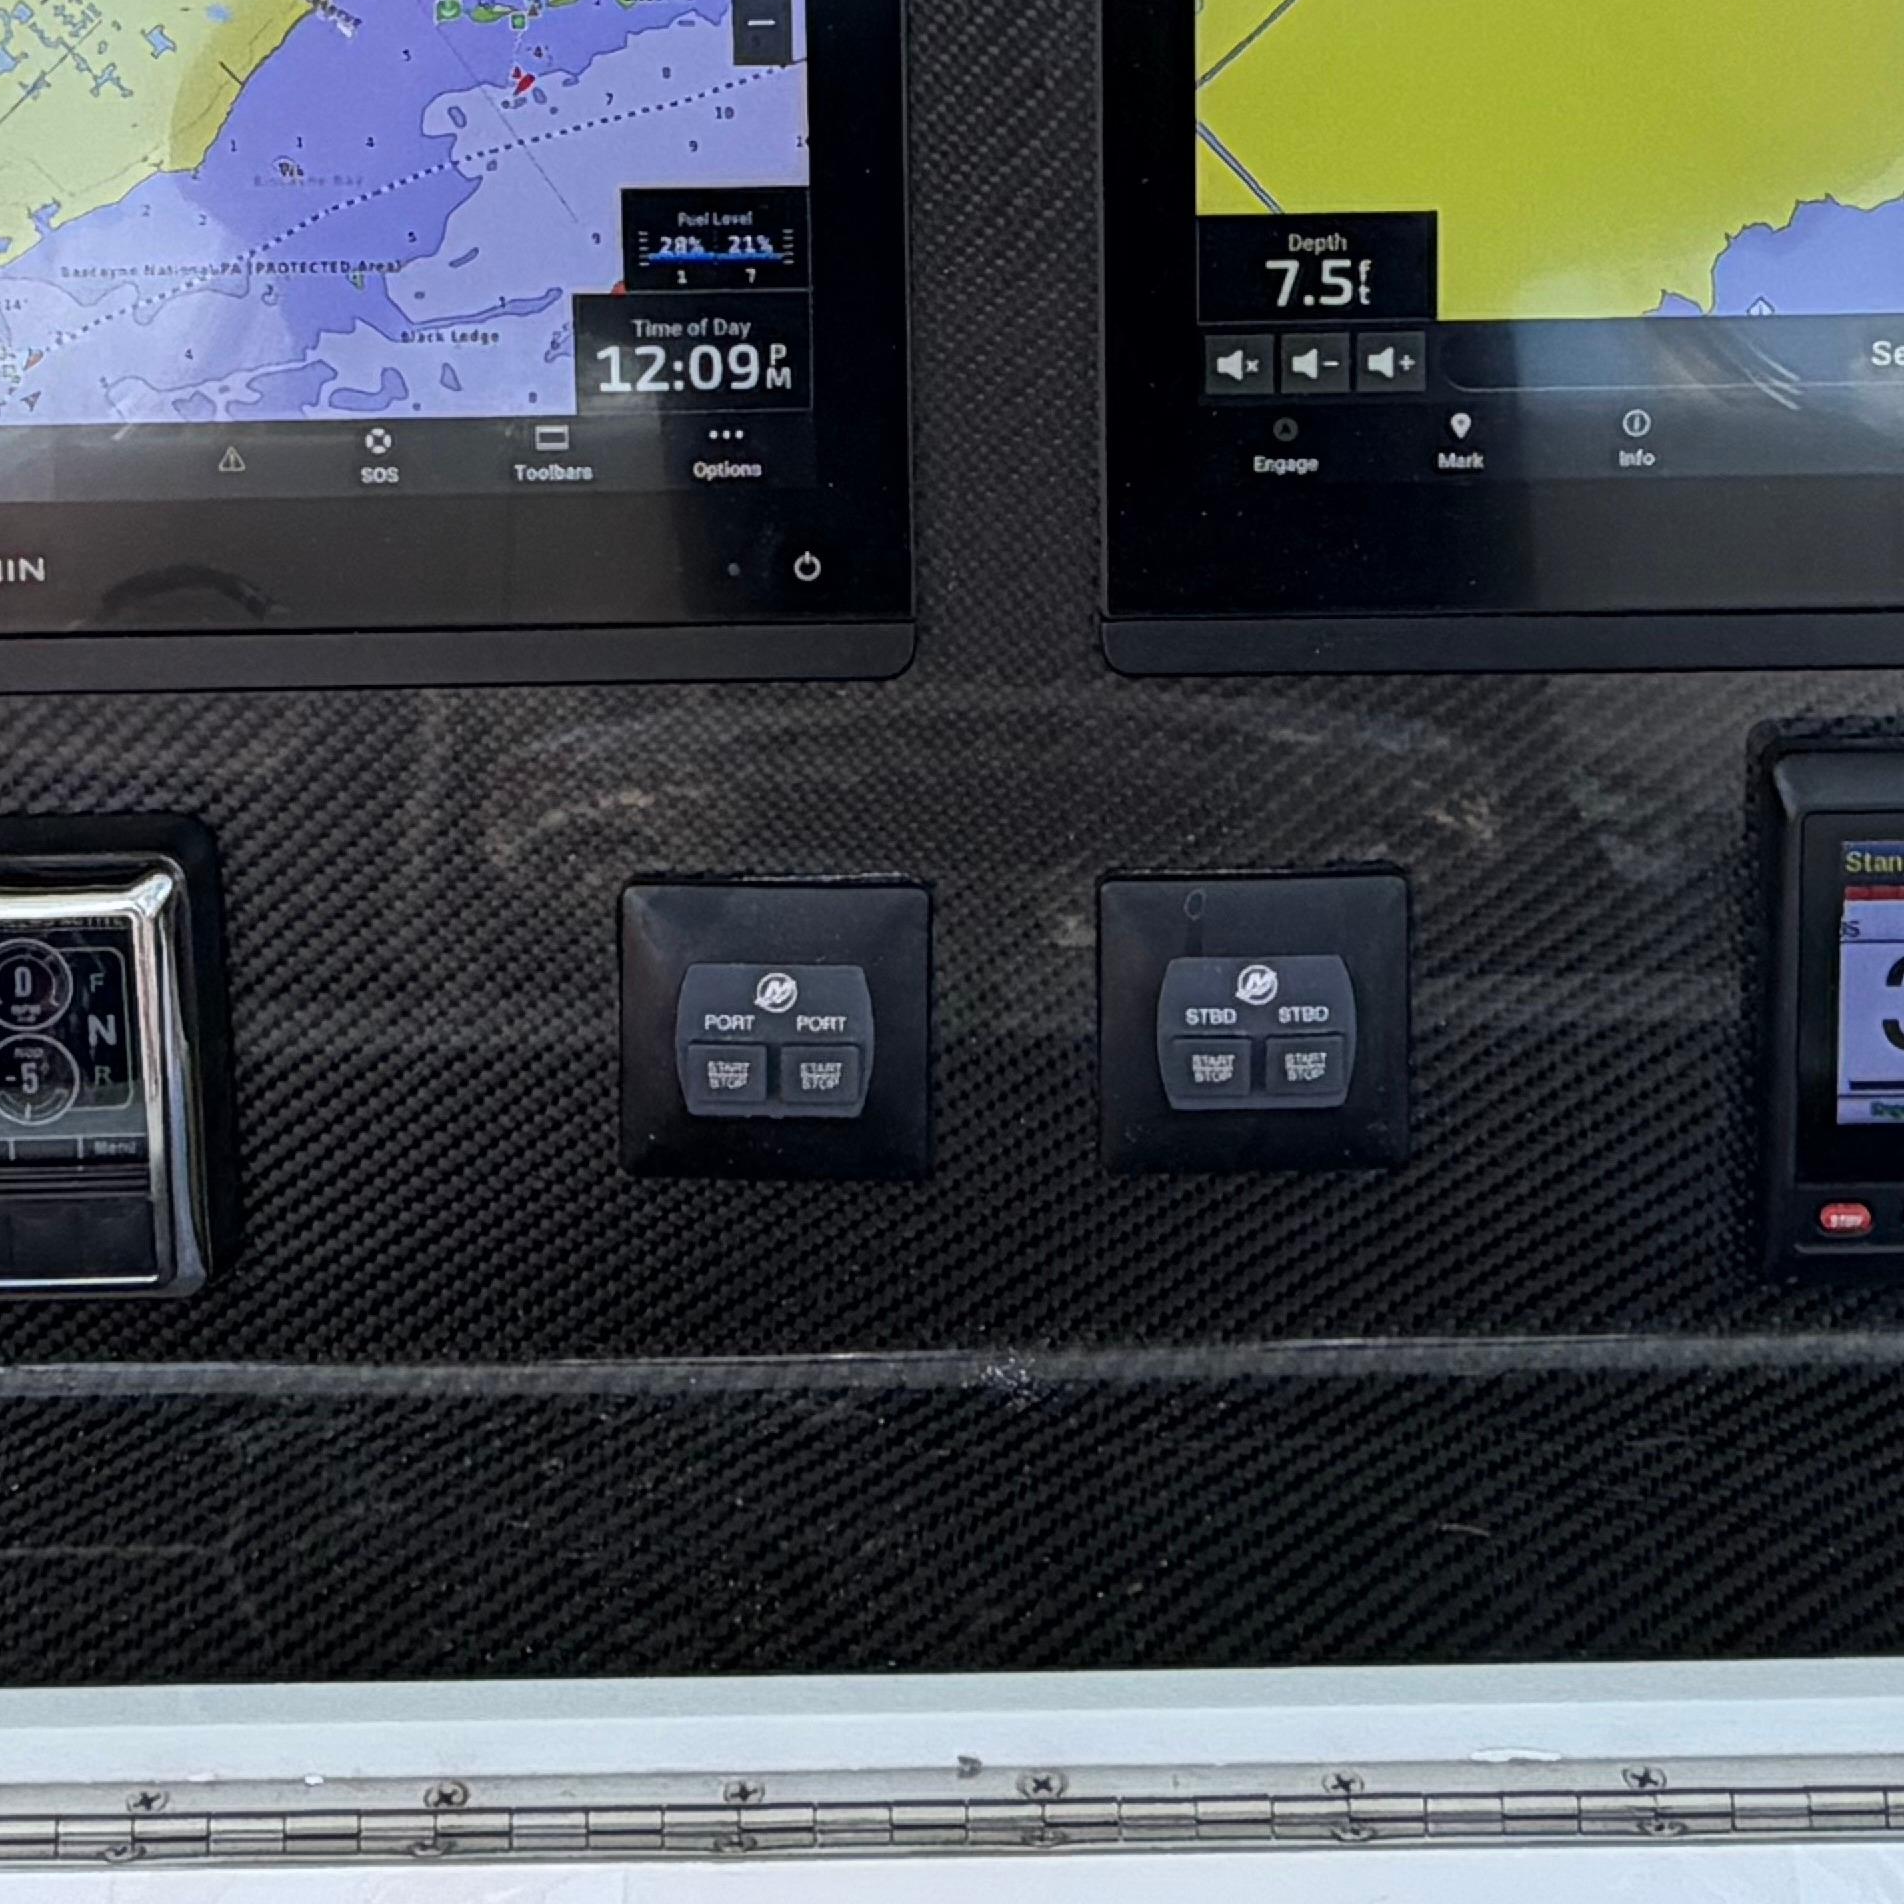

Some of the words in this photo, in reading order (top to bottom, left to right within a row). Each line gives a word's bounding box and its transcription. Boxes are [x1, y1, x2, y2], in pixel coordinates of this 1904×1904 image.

[712, 211, 753, 227] Level
[1288, 233, 1348, 256] Depth
[1265, 259, 1354, 307] 7.5
[632, 319, 683, 338] Time
[688, 318, 708, 338] of
[713, 318, 752, 340] Day
[596, 343, 761, 393] 12:09
[1253, 455, 1319, 476] Engage
[1437, 452, 1485, 471] Mark
[1618, 448, 1656, 468] Info
[360, 466, 400, 484] SOS
[514, 464, 594, 482] Toolbars
[692, 461, 763, 480] Options
[90, 972, 105, 993] F
[704, 1014, 756, 1031] PORT
[797, 1014, 847, 1032] PORT
[1185, 1008, 1237, 1026] STBD
[1279, 1006, 1330, 1024] STBD
[88, 1013, 117, 1046] N
